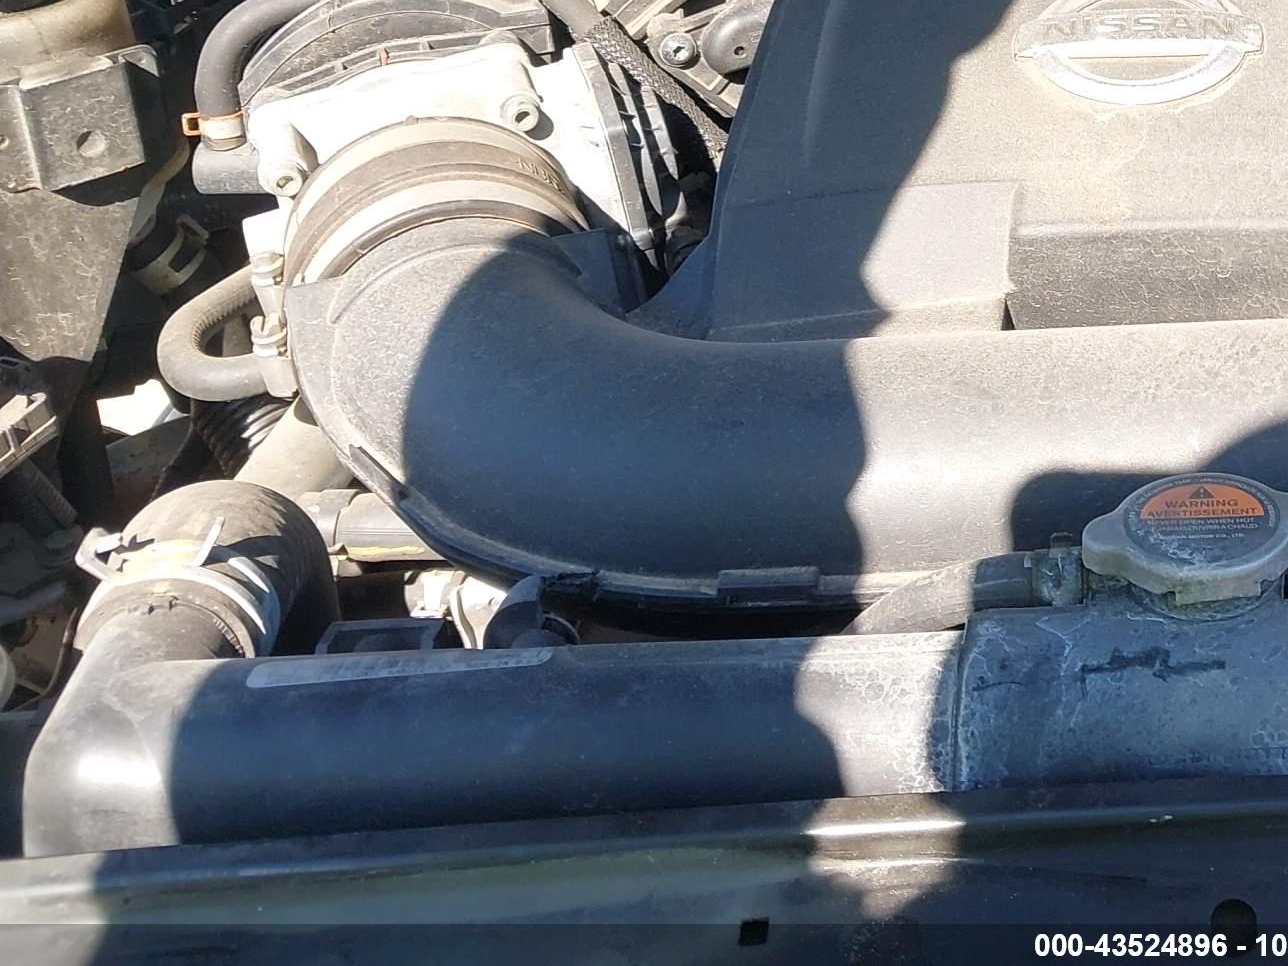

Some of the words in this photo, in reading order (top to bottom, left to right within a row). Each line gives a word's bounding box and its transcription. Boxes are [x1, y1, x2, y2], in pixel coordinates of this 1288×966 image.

[1044, 14, 1237, 35] NISSAN
[1164, 498, 1239, 509] WARNING
[1147, 507, 1258, 519] AVERTISSEMENT
